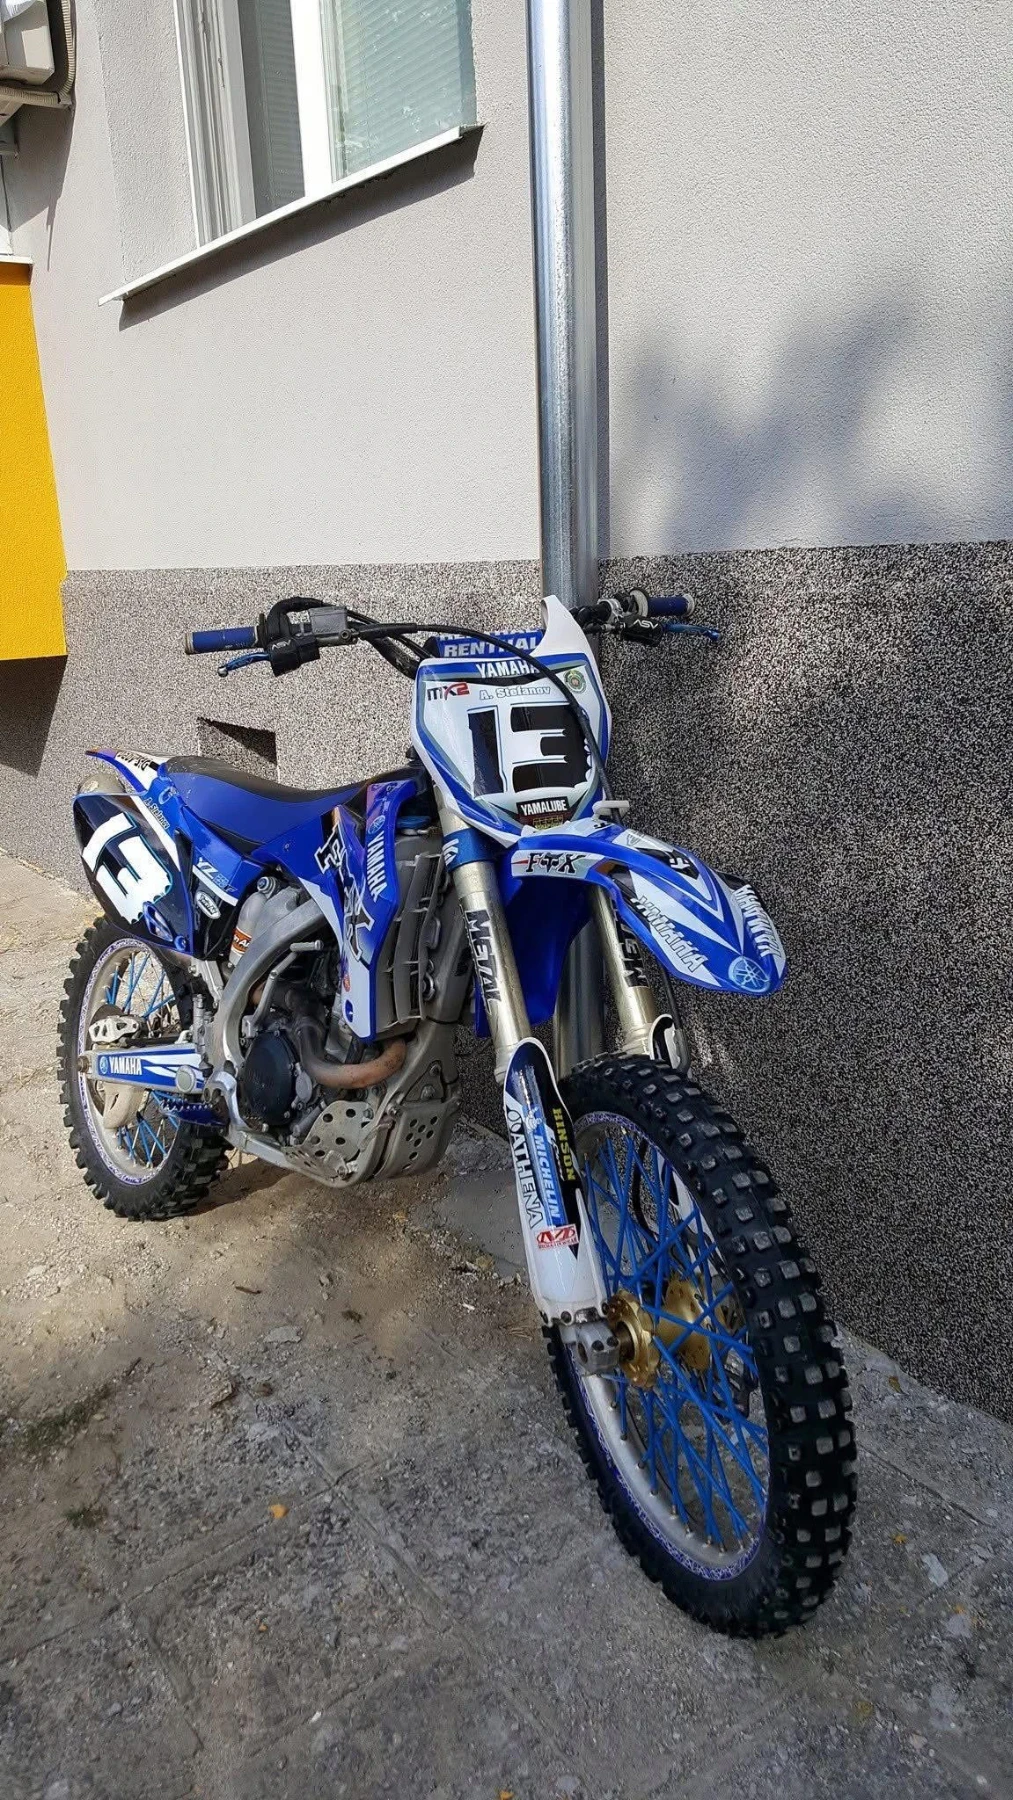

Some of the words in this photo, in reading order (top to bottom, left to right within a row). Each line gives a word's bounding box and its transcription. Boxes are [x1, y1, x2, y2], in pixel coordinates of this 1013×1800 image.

[497, 685, 551, 698] Stefanov
[467, 702, 593, 798] 13
[521, 800, 568, 816] YAMALUBE
[367, 831, 388, 902] YAMAHA
[630, 895, 709, 973] YAMAHA
[109, 1056, 143, 1075] YAMAHA
[509, 1132, 544, 1229] ATHENA
[533, 1134, 562, 1220] MICHELIN
[552, 1107, 577, 1181] HINSON
